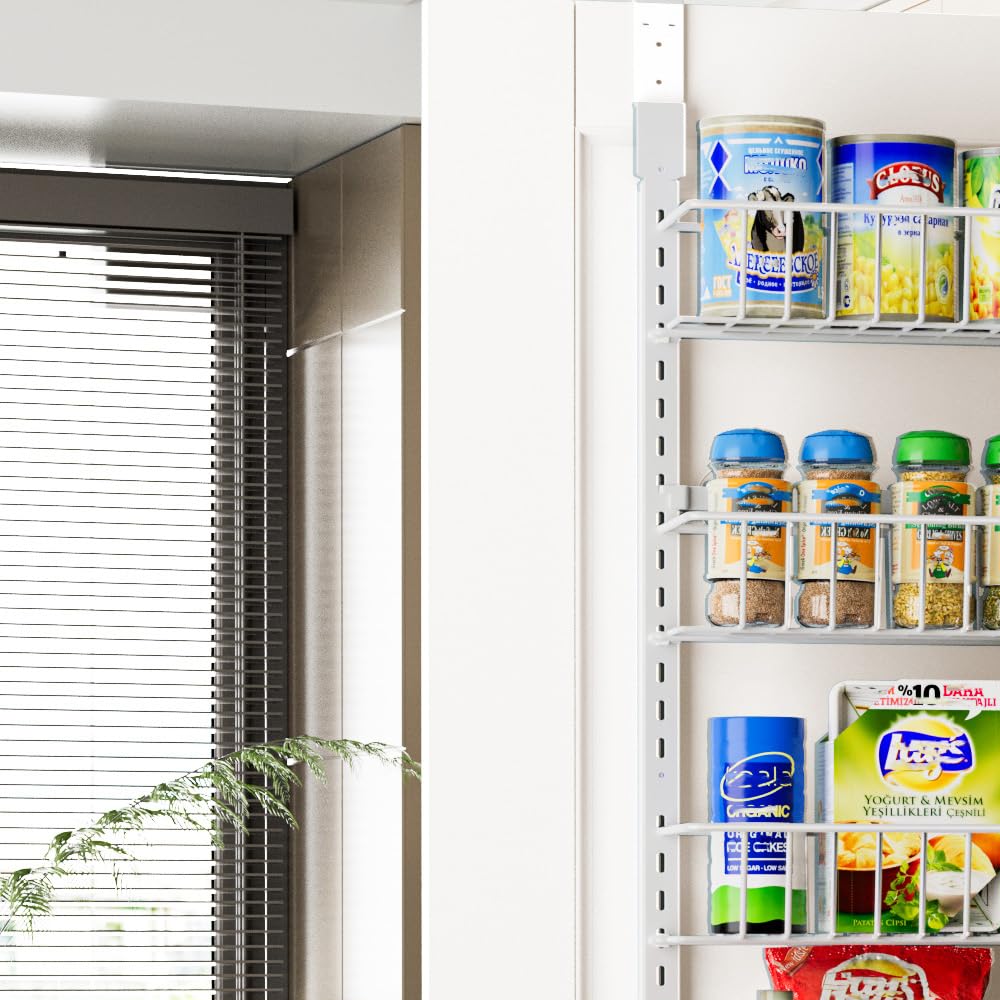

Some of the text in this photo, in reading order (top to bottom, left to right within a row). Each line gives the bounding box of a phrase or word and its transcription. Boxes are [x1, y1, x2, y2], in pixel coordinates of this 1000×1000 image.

[863, 213, 949, 228] Кууруза саарная
[904, 229, 922, 238] зерна
[864, 793, 983, 806] YOĞURT & MEVSİM
[863, 806, 986, 818] YEŞİLLİKLERİ ÇEŞNİLİ
[853, 918, 883, 927] PATATS
